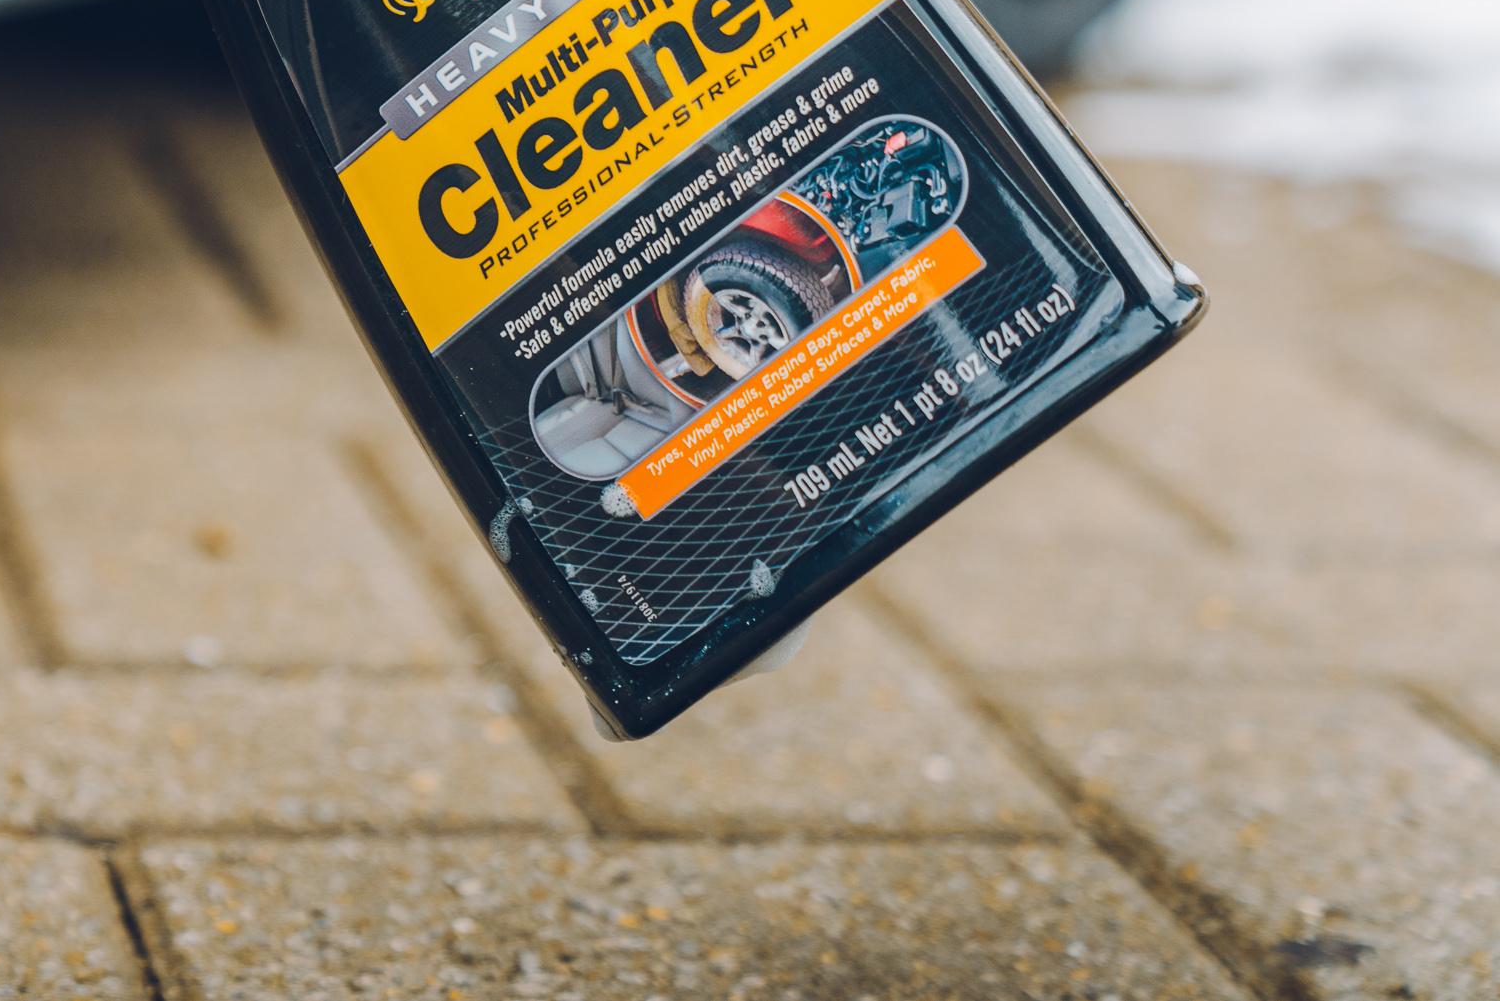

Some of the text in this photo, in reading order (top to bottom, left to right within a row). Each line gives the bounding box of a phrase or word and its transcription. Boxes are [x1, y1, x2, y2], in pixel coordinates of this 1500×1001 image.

[478, 17, 809, 280] PROFESSIONAL-STRENGTH
[500, 66, 854, 340] -Powerful formula easily removes dirt, grease & grime
[515, 77, 880, 360] -Safe & effective on vinyl, rubber, plastic, fabric & more
[646, 256, 936, 477] Tyres, Wheel Wells, Engine Bays, Carpet, Fabric,
[689, 292, 917, 468] Vinyl, Plastic, Rubber Surfaces & More
[783, 283, 1076, 508] 709 mL Net 1 pt 8 oz (24 fl oz)
[617, 574, 658, 623] 30811974
